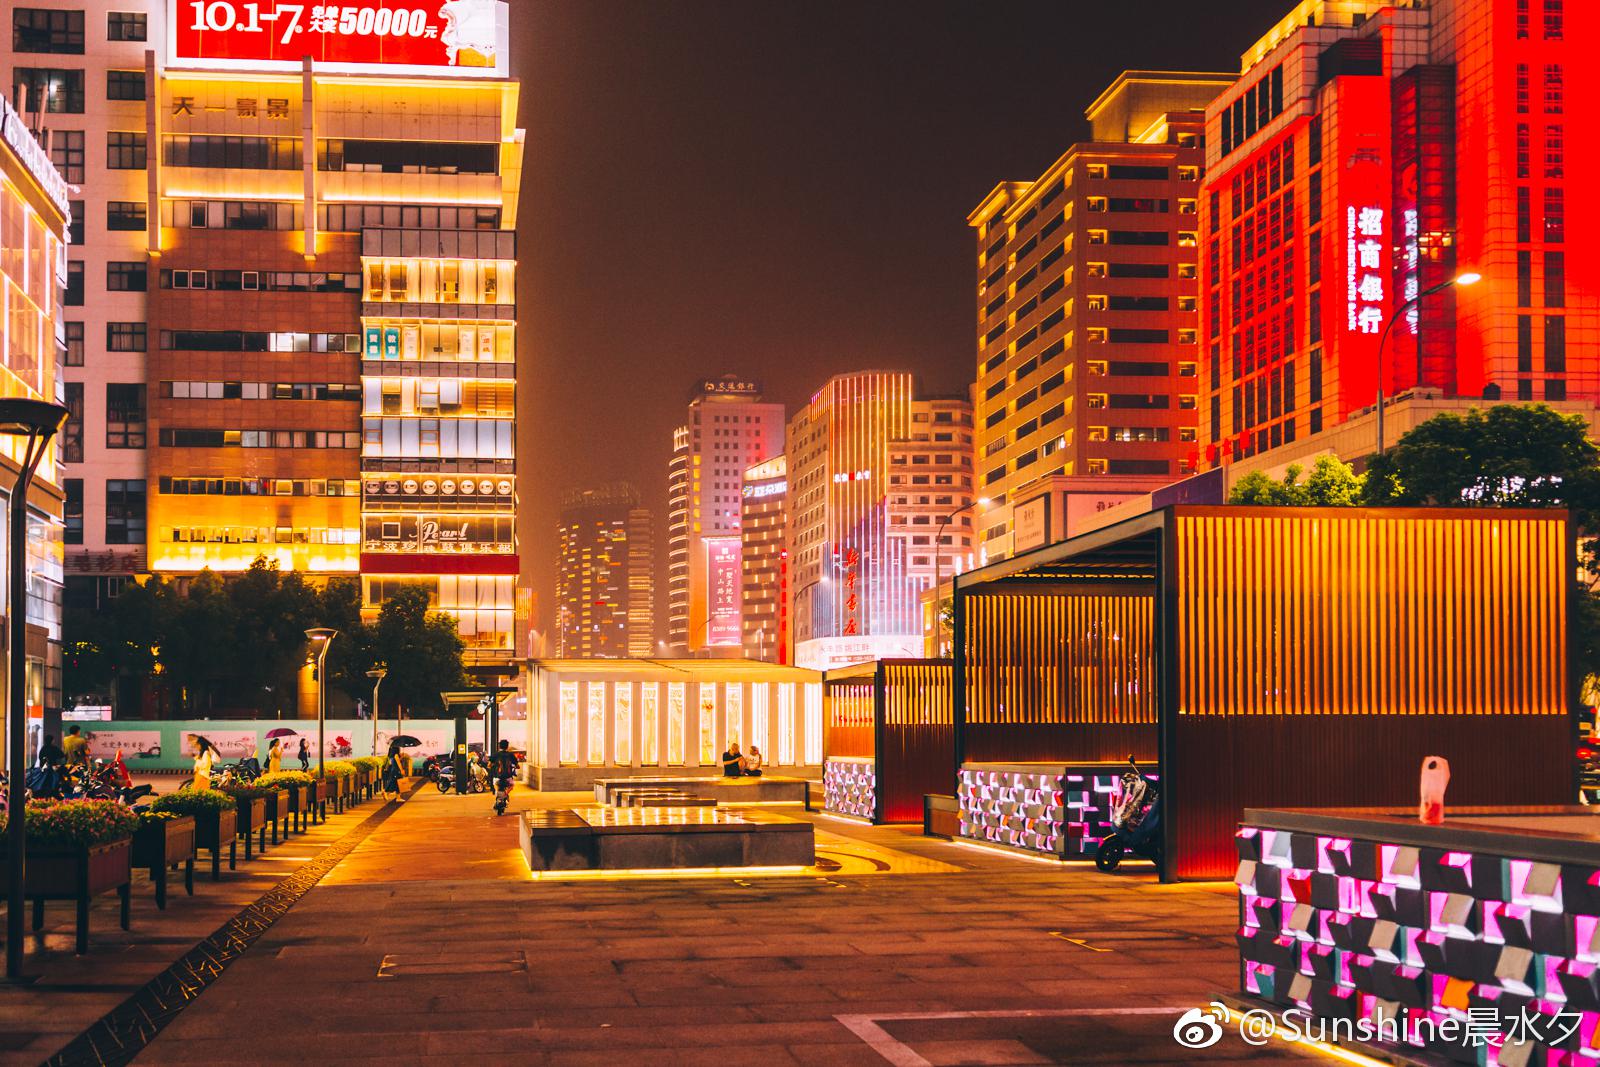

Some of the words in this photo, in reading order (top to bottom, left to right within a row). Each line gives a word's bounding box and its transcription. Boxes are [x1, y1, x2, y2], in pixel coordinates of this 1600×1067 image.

[308, 19, 338, 33] 大奖
[338, 7, 439, 39] 50000元
[172, 97, 290, 120] 天一豪景
[1357, 206, 1383, 333] 招商银行
[408, 521, 469, 541] Pearl
[716, 567, 725, 604] 中山路上
